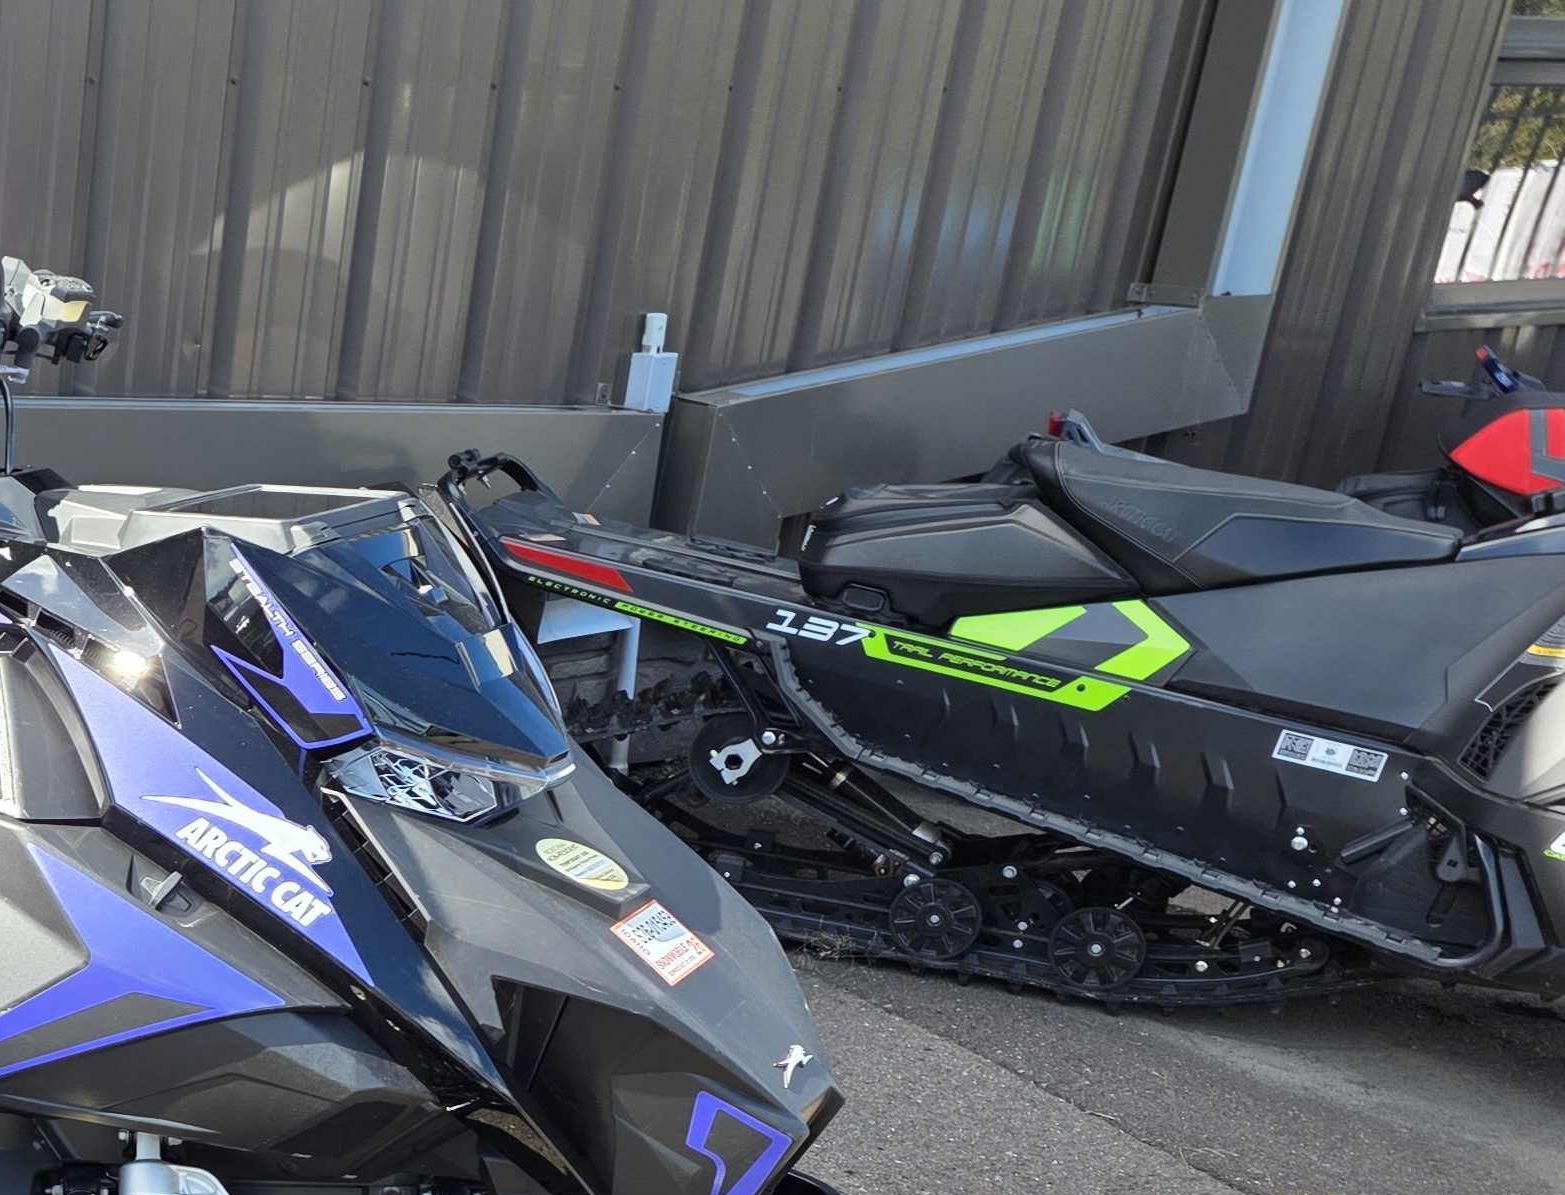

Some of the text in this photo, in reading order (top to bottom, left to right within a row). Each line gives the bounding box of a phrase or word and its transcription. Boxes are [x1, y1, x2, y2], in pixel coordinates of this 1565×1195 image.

[229, 558, 347, 701] STEALTH SERIES
[527, 575, 741, 642] ELECTRONIC POWER STEERING
[766, 609, 872, 646] 137
[892, 640, 1062, 688] TRAIL PERFORMANCE
[175, 817, 333, 927] ARCTIC CAT
[621, 928, 651, 956] IDAHO
